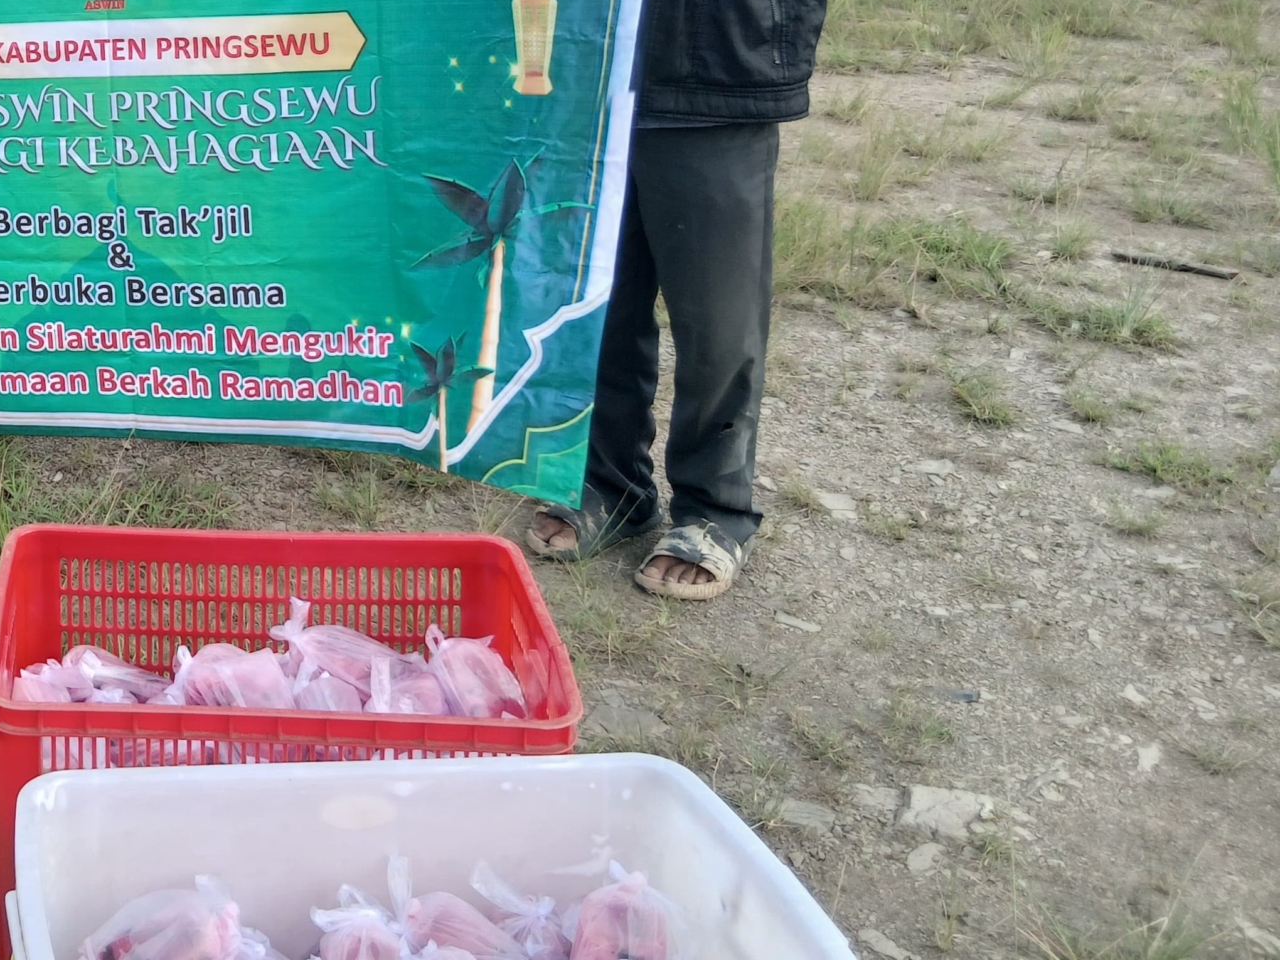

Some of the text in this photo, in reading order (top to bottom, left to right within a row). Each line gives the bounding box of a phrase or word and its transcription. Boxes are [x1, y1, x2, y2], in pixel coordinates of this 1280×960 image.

[84, 0, 126, 11] ASWIN
[156, 32, 330, 60] PRINGSEWU
[108, 75, 383, 130] PRINGSEWU
[56, 125, 389, 174] KEBAHAGIAAN
[108, 241, 135, 270] &
[126, 277, 287, 308] Bersama
[26, 321, 217, 355] Silaturahmi
[224, 323, 394, 362] Mengukir
[96, 365, 212, 399] Berkah
[219, 370, 404, 407] Ramadhan
